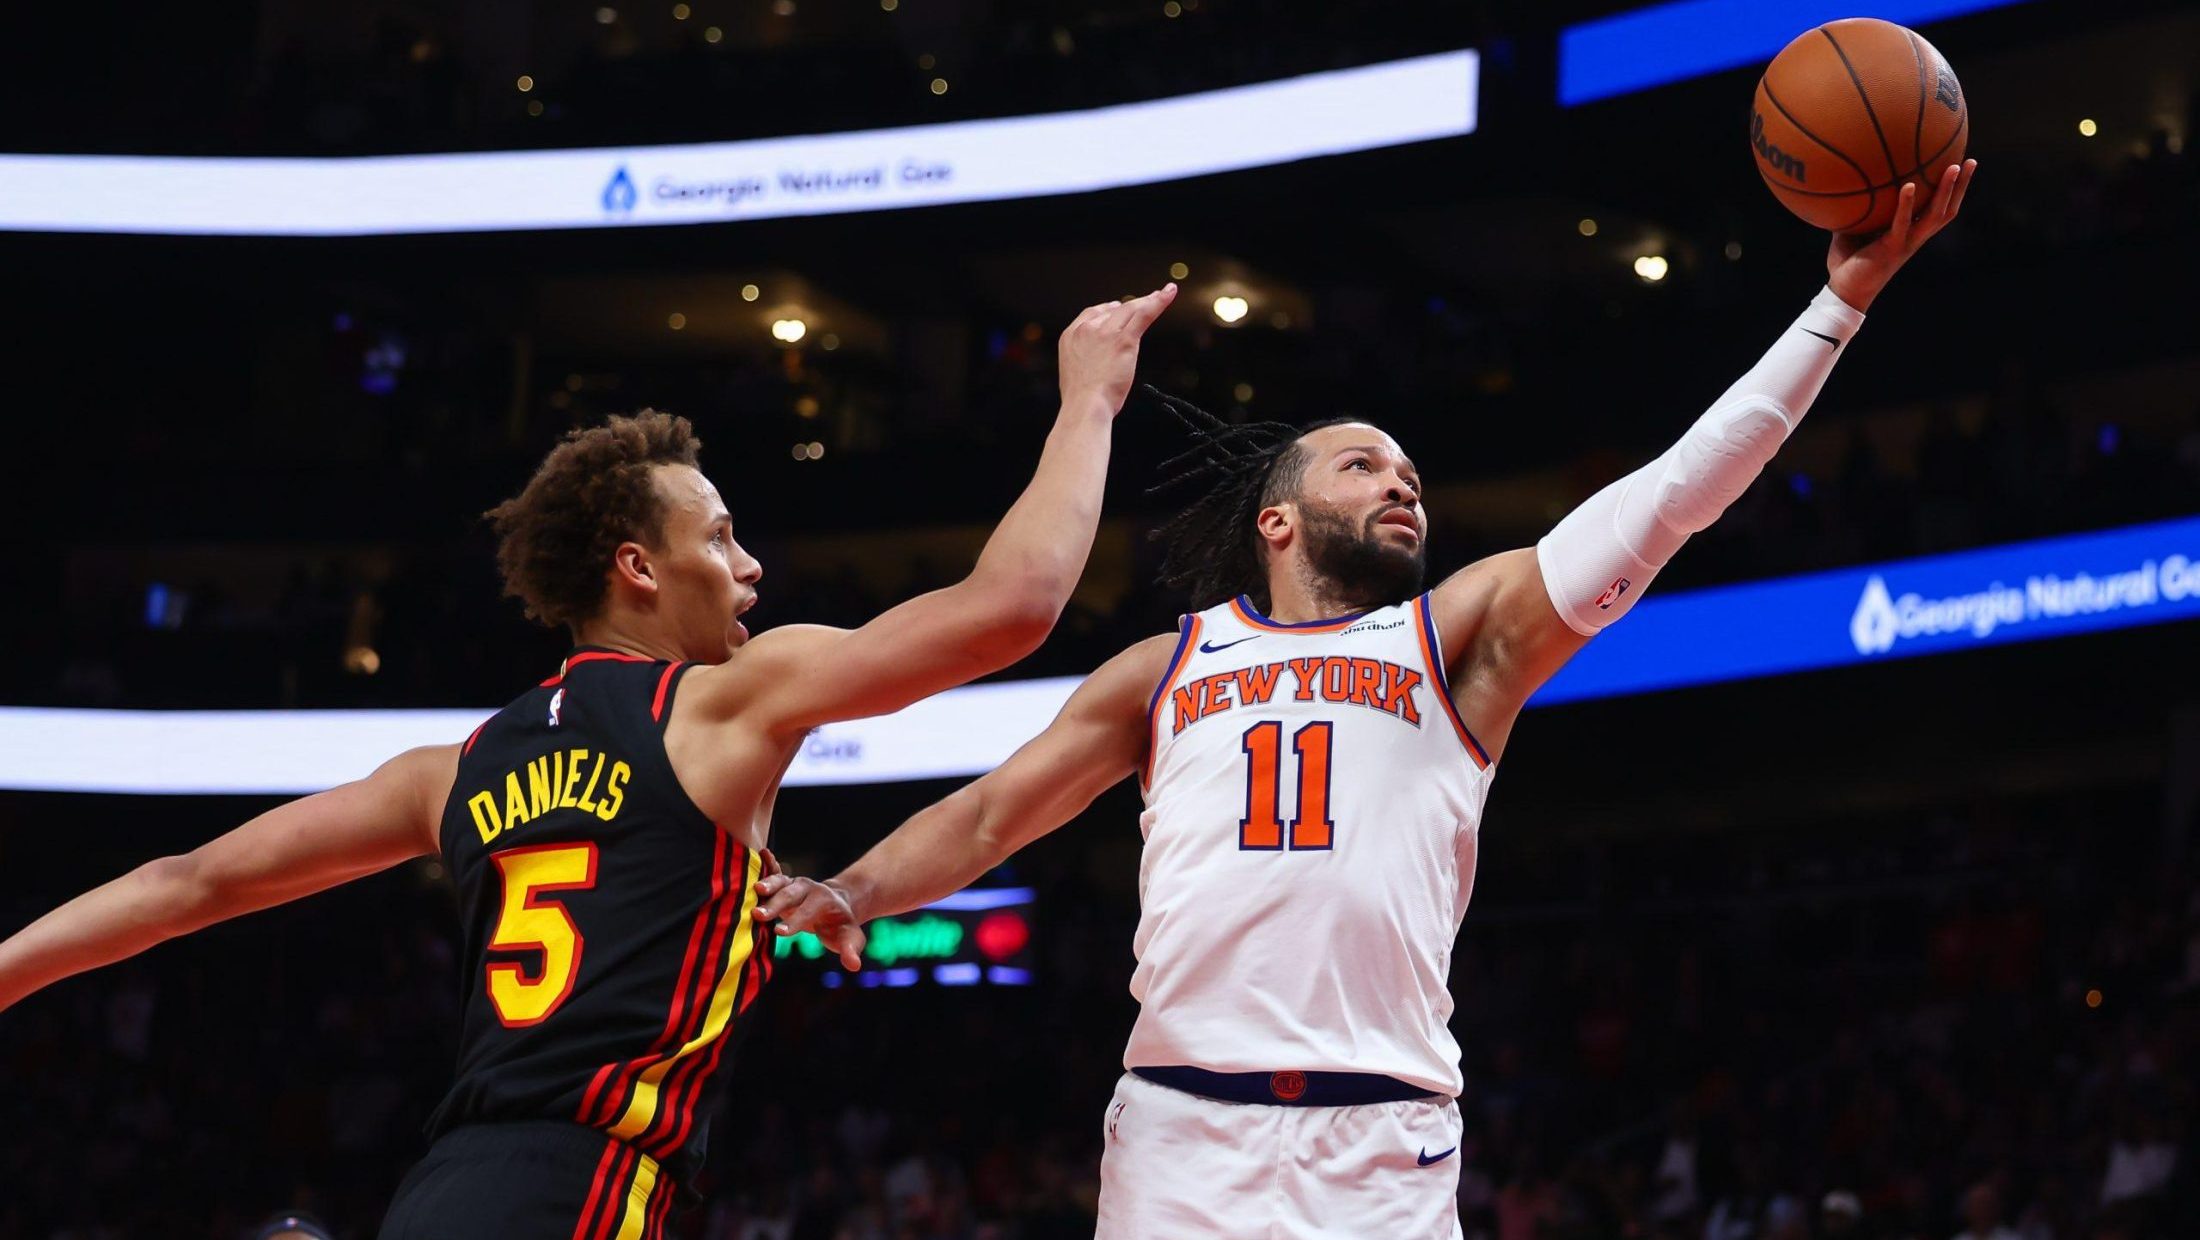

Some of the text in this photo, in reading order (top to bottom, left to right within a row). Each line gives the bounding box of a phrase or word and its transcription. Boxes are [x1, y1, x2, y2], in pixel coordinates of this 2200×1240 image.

[1172, 655, 1424, 739] NEW YORK
[468, 749, 631, 844] DANIELS
[1239, 720, 1335, 851] 11
[486, 841, 600, 1028] 5
